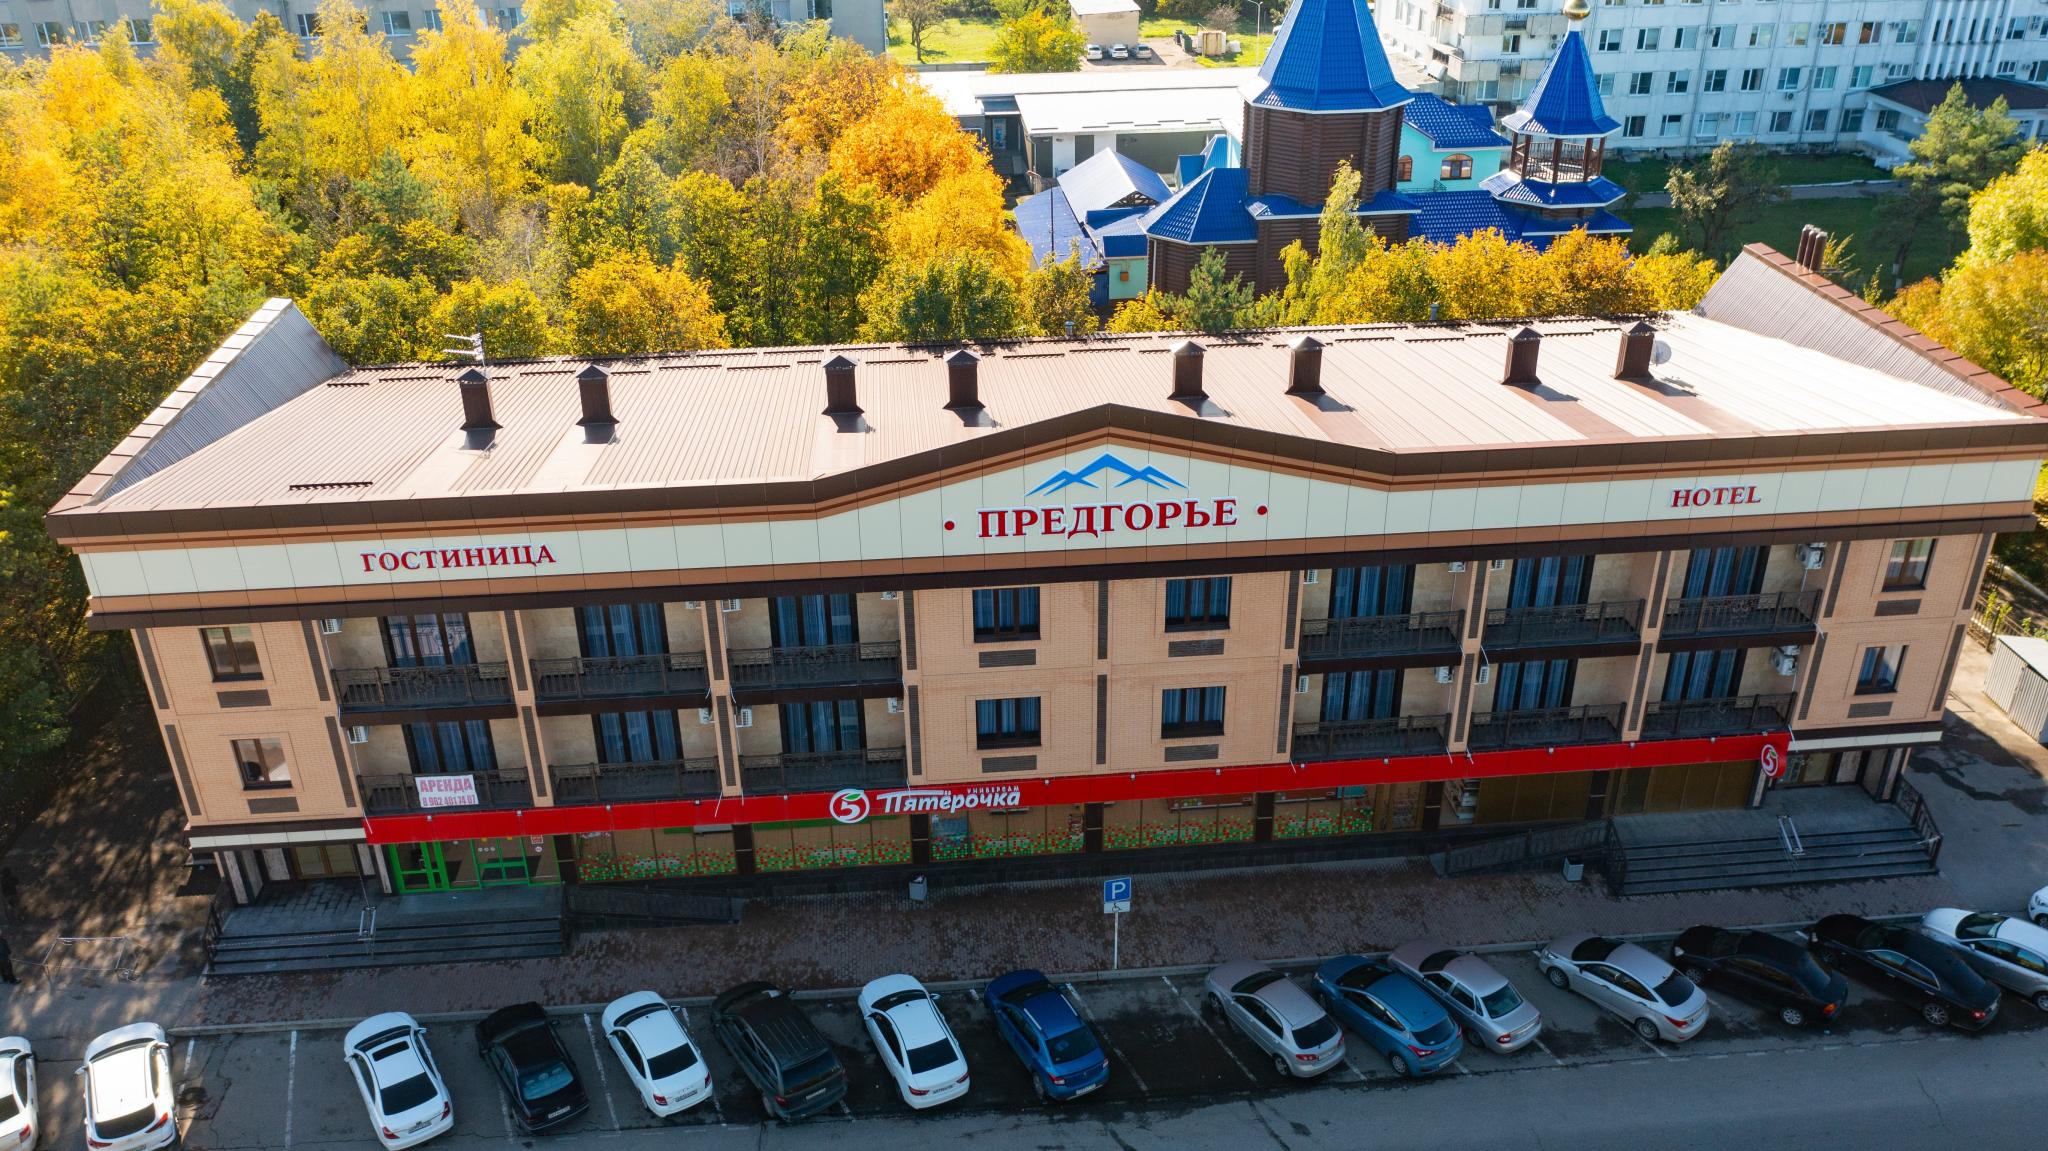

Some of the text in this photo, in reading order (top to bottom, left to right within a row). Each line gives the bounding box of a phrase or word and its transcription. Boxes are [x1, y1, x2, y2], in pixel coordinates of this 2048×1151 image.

[1670, 486, 1762, 508] HOTEL
[977, 498, 1237, 540] ПРЕДГОРЬЕ
[360, 544, 557, 573] ГОСТИНИЦА
[420, 778, 473, 793] АРЕНДА
[967, 785, 1020, 794] УНИВЕРСАМ
[876, 789, 1020, 814] Пятёрочка
[1111, 881, 1126, 900] P
